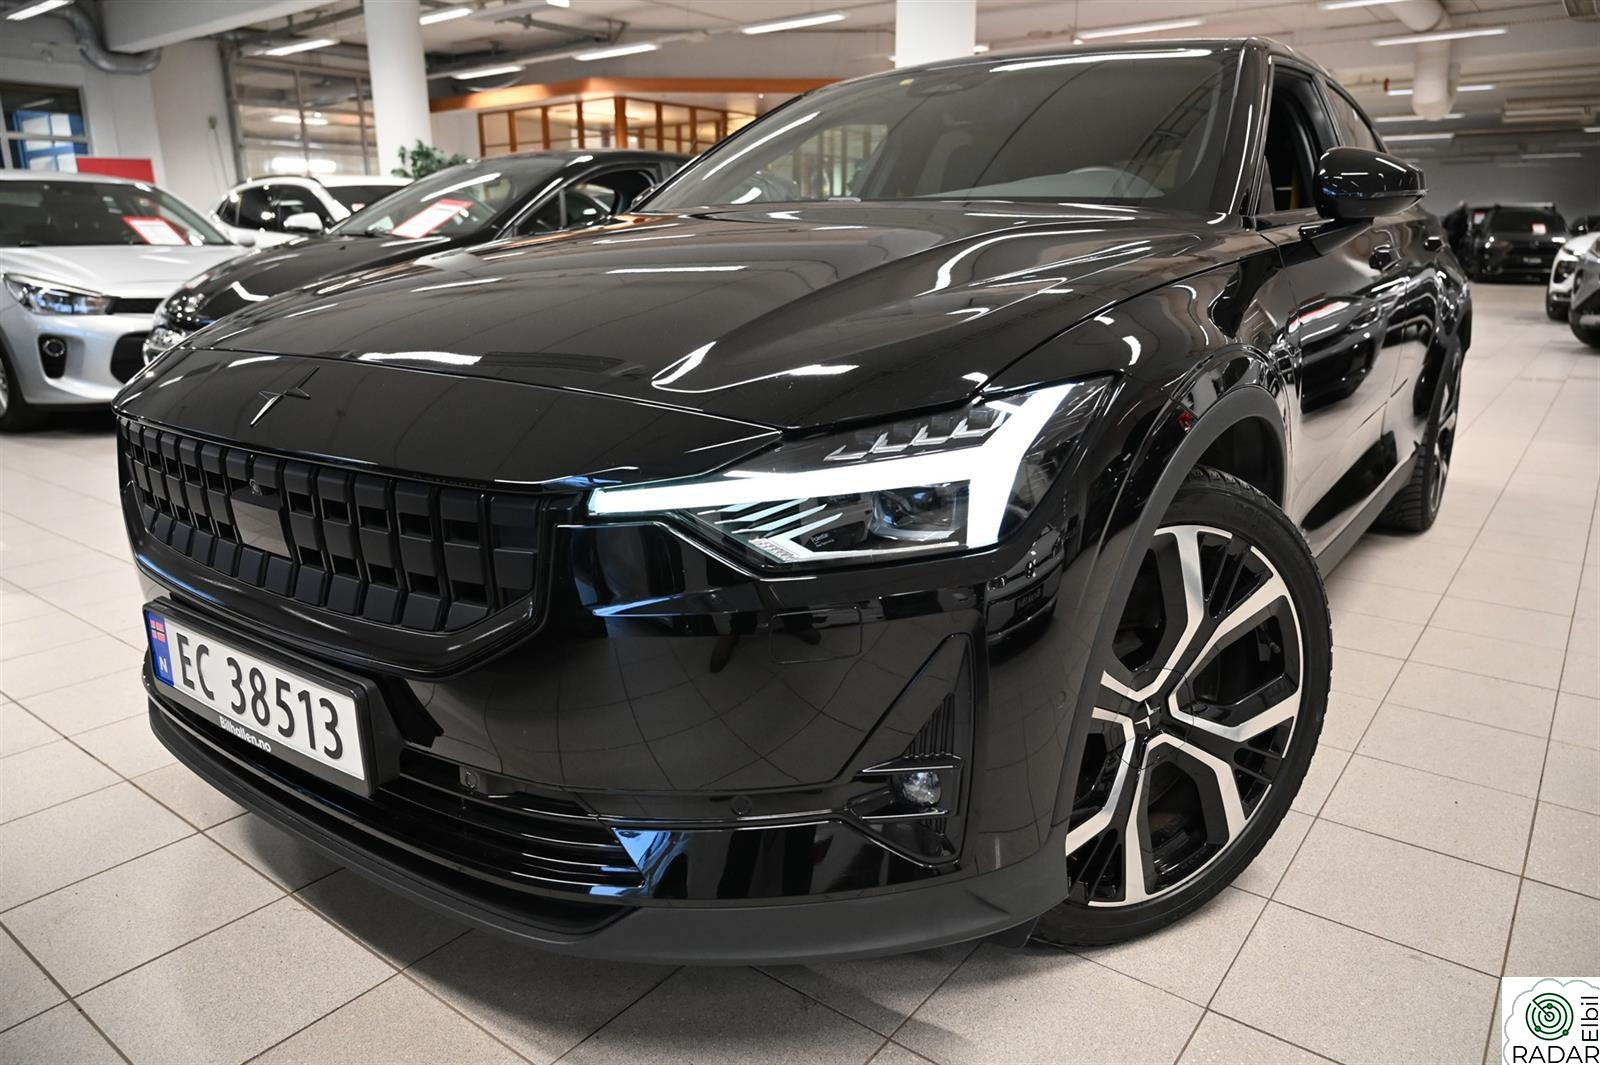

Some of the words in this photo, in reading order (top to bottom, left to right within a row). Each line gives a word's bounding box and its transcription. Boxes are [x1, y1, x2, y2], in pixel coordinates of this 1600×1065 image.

[159, 656, 168, 673] N
[176, 632, 215, 701] EC
[226, 656, 343, 760] 38513
